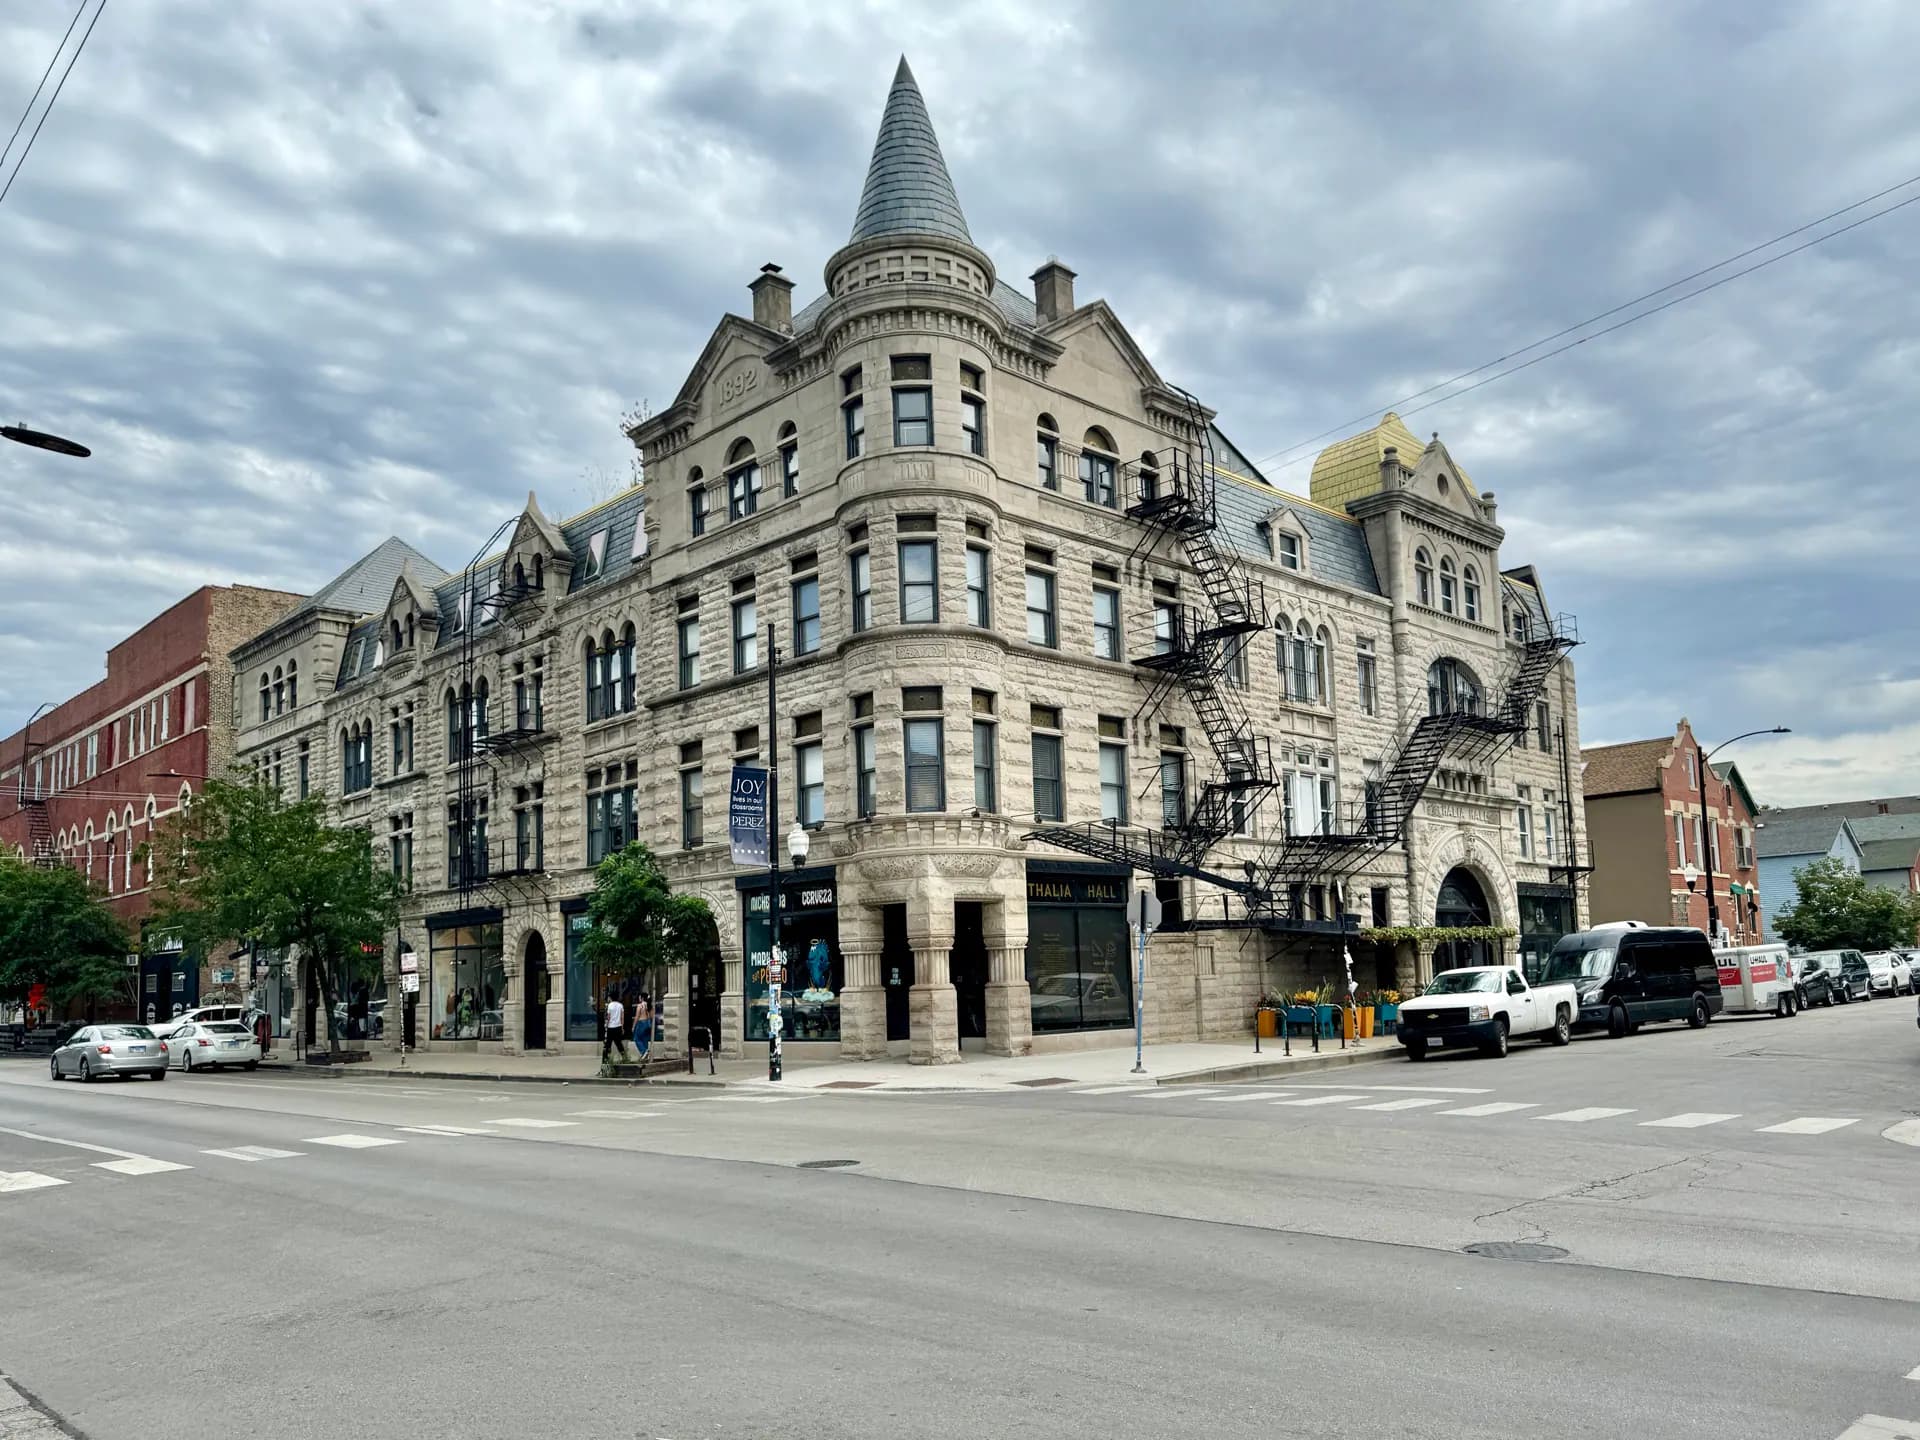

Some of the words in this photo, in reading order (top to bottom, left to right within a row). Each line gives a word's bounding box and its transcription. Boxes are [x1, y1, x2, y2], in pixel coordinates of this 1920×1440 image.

[720, 367, 758, 407] 1892
[733, 779, 764, 795] JOY
[732, 815, 765, 828] PEREZ
[1027, 883, 1072, 898] THALIA
[1087, 884, 1118, 898] HALL
